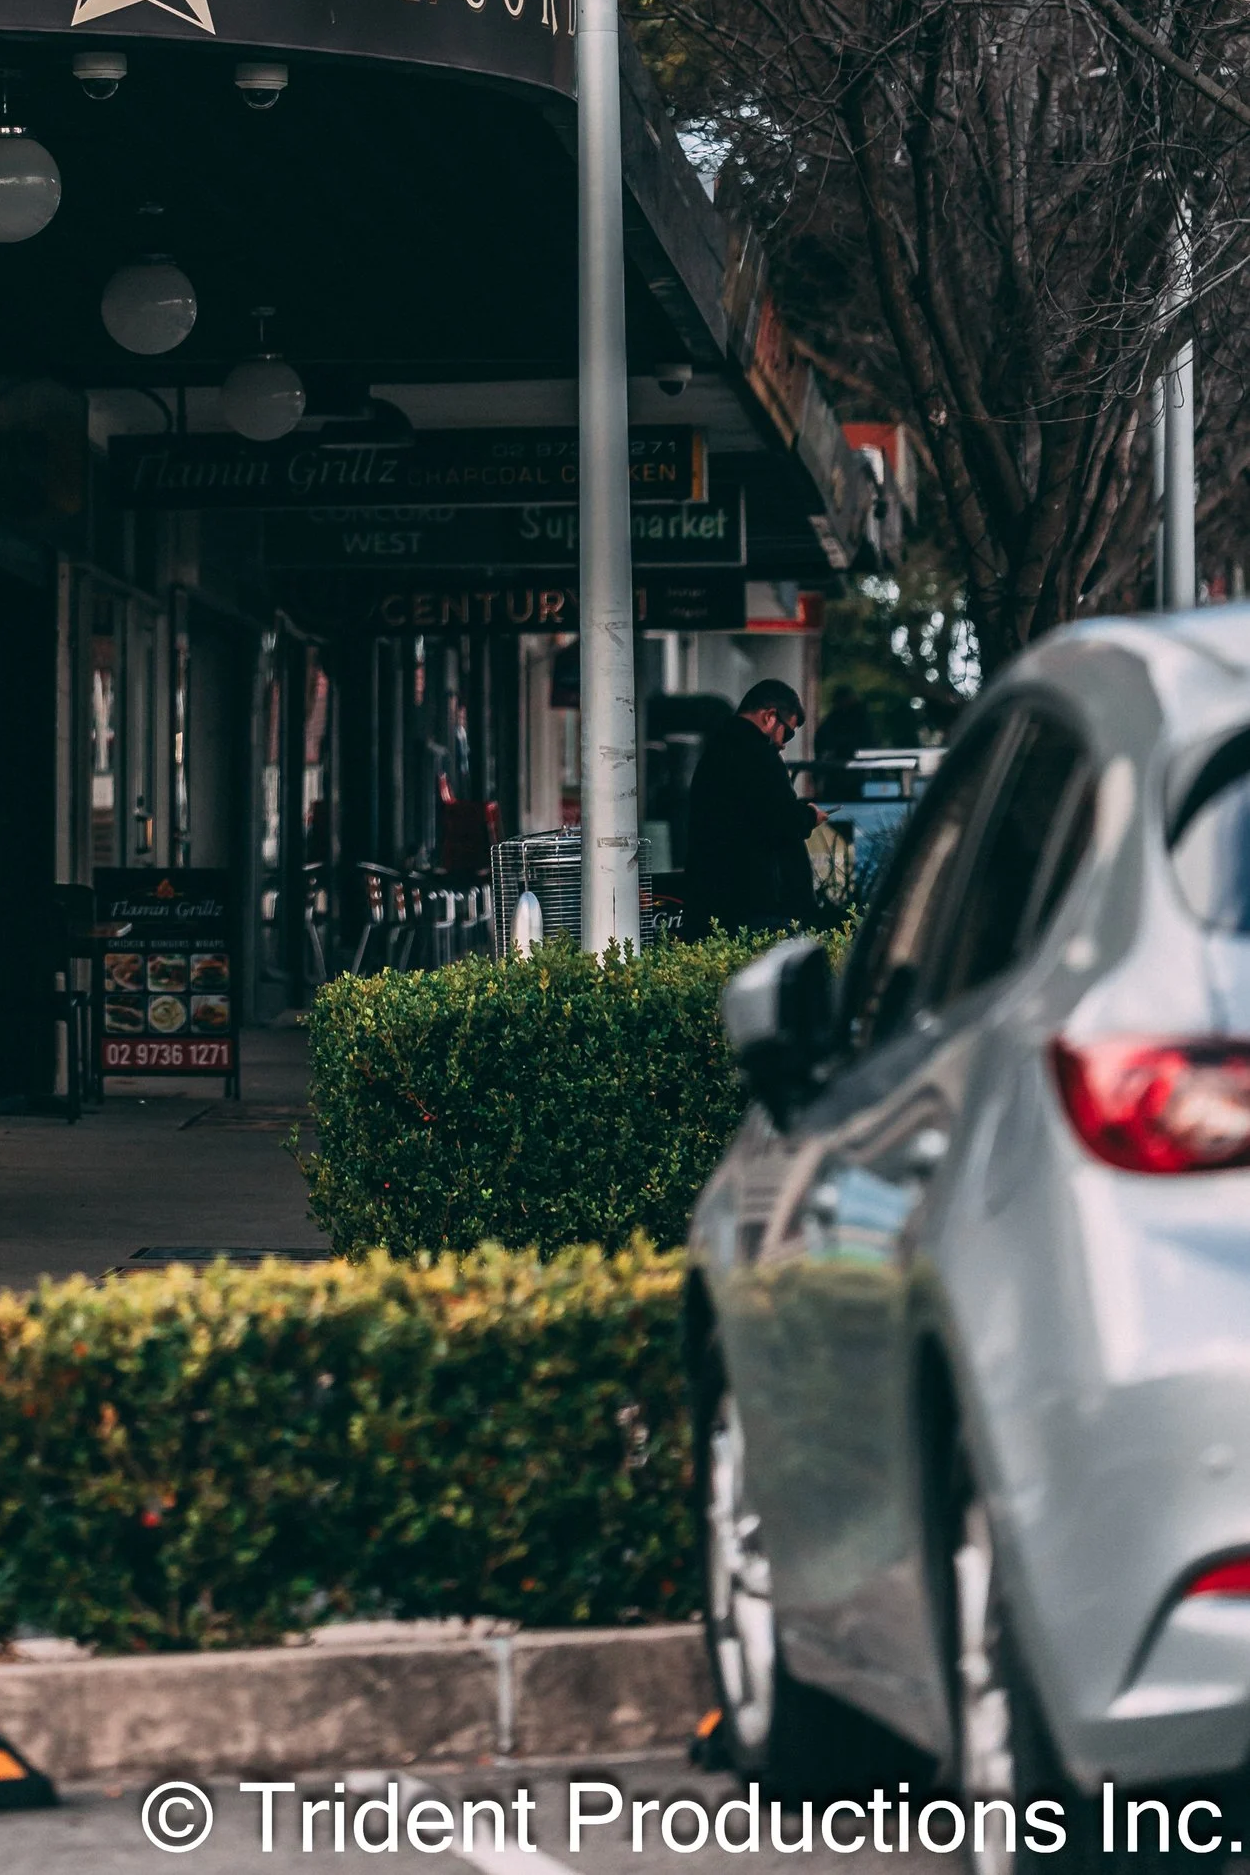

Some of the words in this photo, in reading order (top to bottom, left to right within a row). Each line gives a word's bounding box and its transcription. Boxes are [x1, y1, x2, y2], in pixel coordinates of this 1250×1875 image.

[630, 440, 677, 457] 271
[561, 462, 677, 485] CKEN
[342, 531, 423, 555] WEST
[106, 1043, 131, 1066] 02
[136, 1043, 183, 1066] 9736
[190, 1043, 229, 1066] 1271
